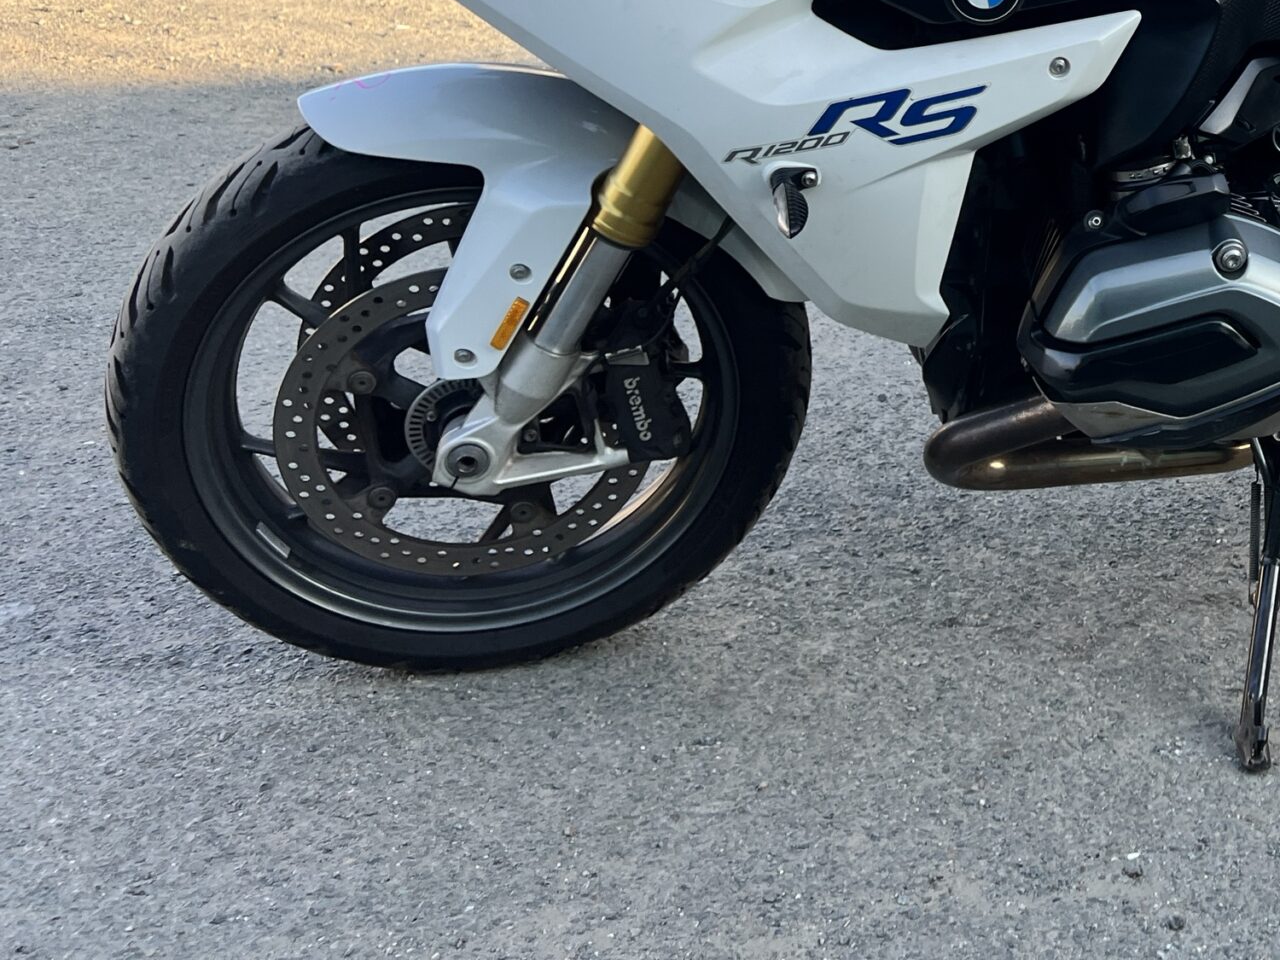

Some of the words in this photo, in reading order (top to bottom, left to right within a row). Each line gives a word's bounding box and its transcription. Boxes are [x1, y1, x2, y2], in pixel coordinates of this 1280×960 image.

[807, 85, 988, 146] RS
[723, 131, 851, 164] R1200
[623, 376, 652, 441] brembo
